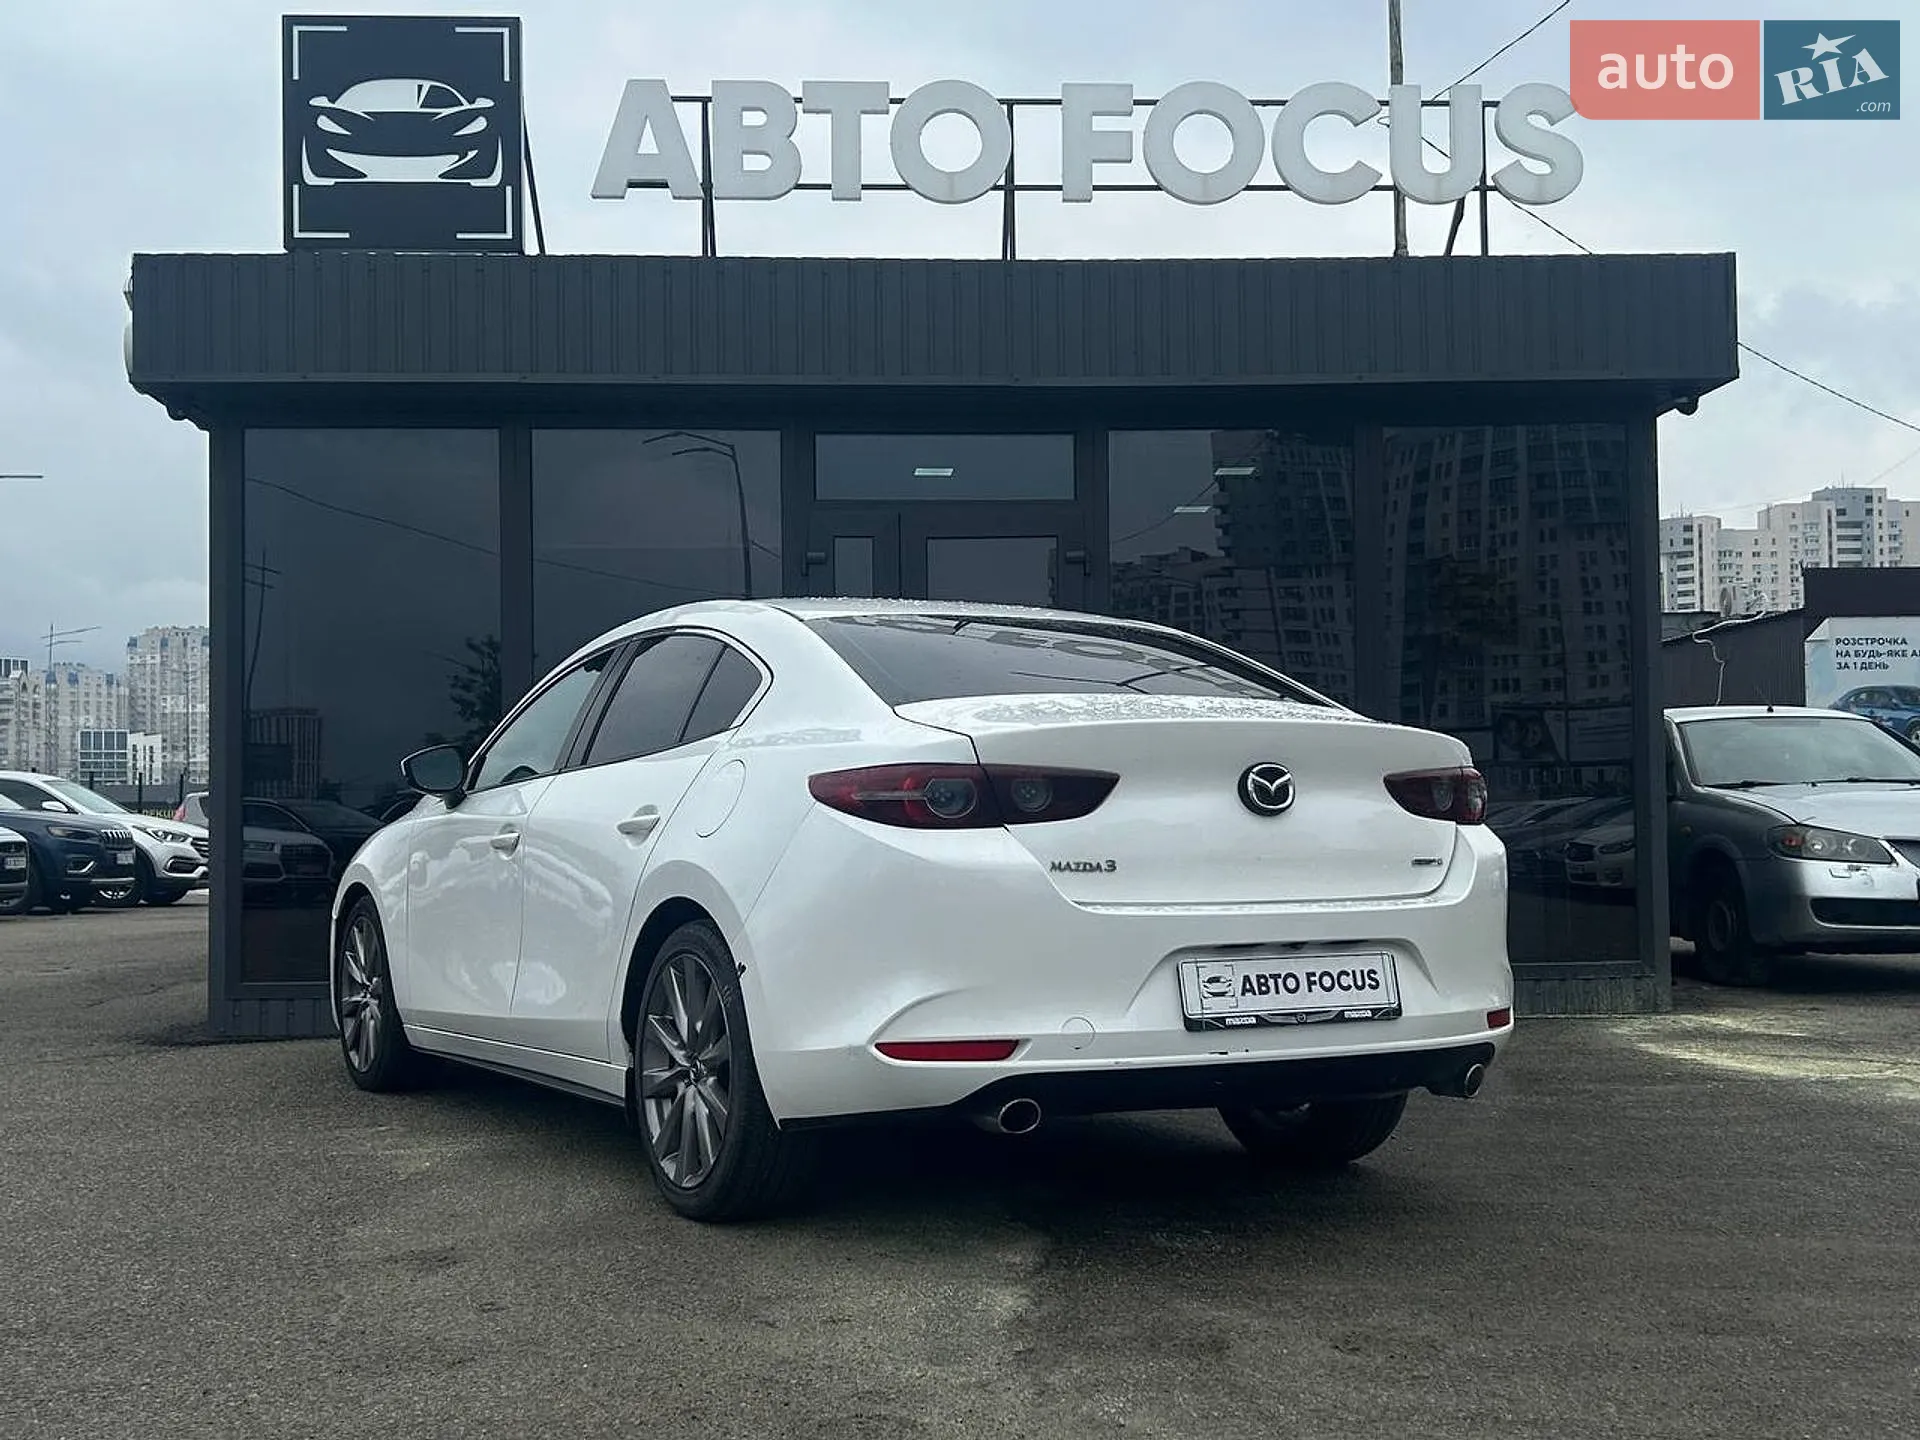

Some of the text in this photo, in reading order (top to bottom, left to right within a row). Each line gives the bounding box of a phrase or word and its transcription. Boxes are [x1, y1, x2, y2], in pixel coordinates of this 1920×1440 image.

[591, 79, 1584, 206] АВТО FOCUS
[1835, 637, 1908, 646] РОЗСТРОЧКА
[1836, 649, 1920, 659] НА БУДЬ-ЯКЕ А
[1836, 661, 1890, 671] ЗА 1 ДЕНЬ
[1240, 968, 1381, 997] АВТО FOCUS
